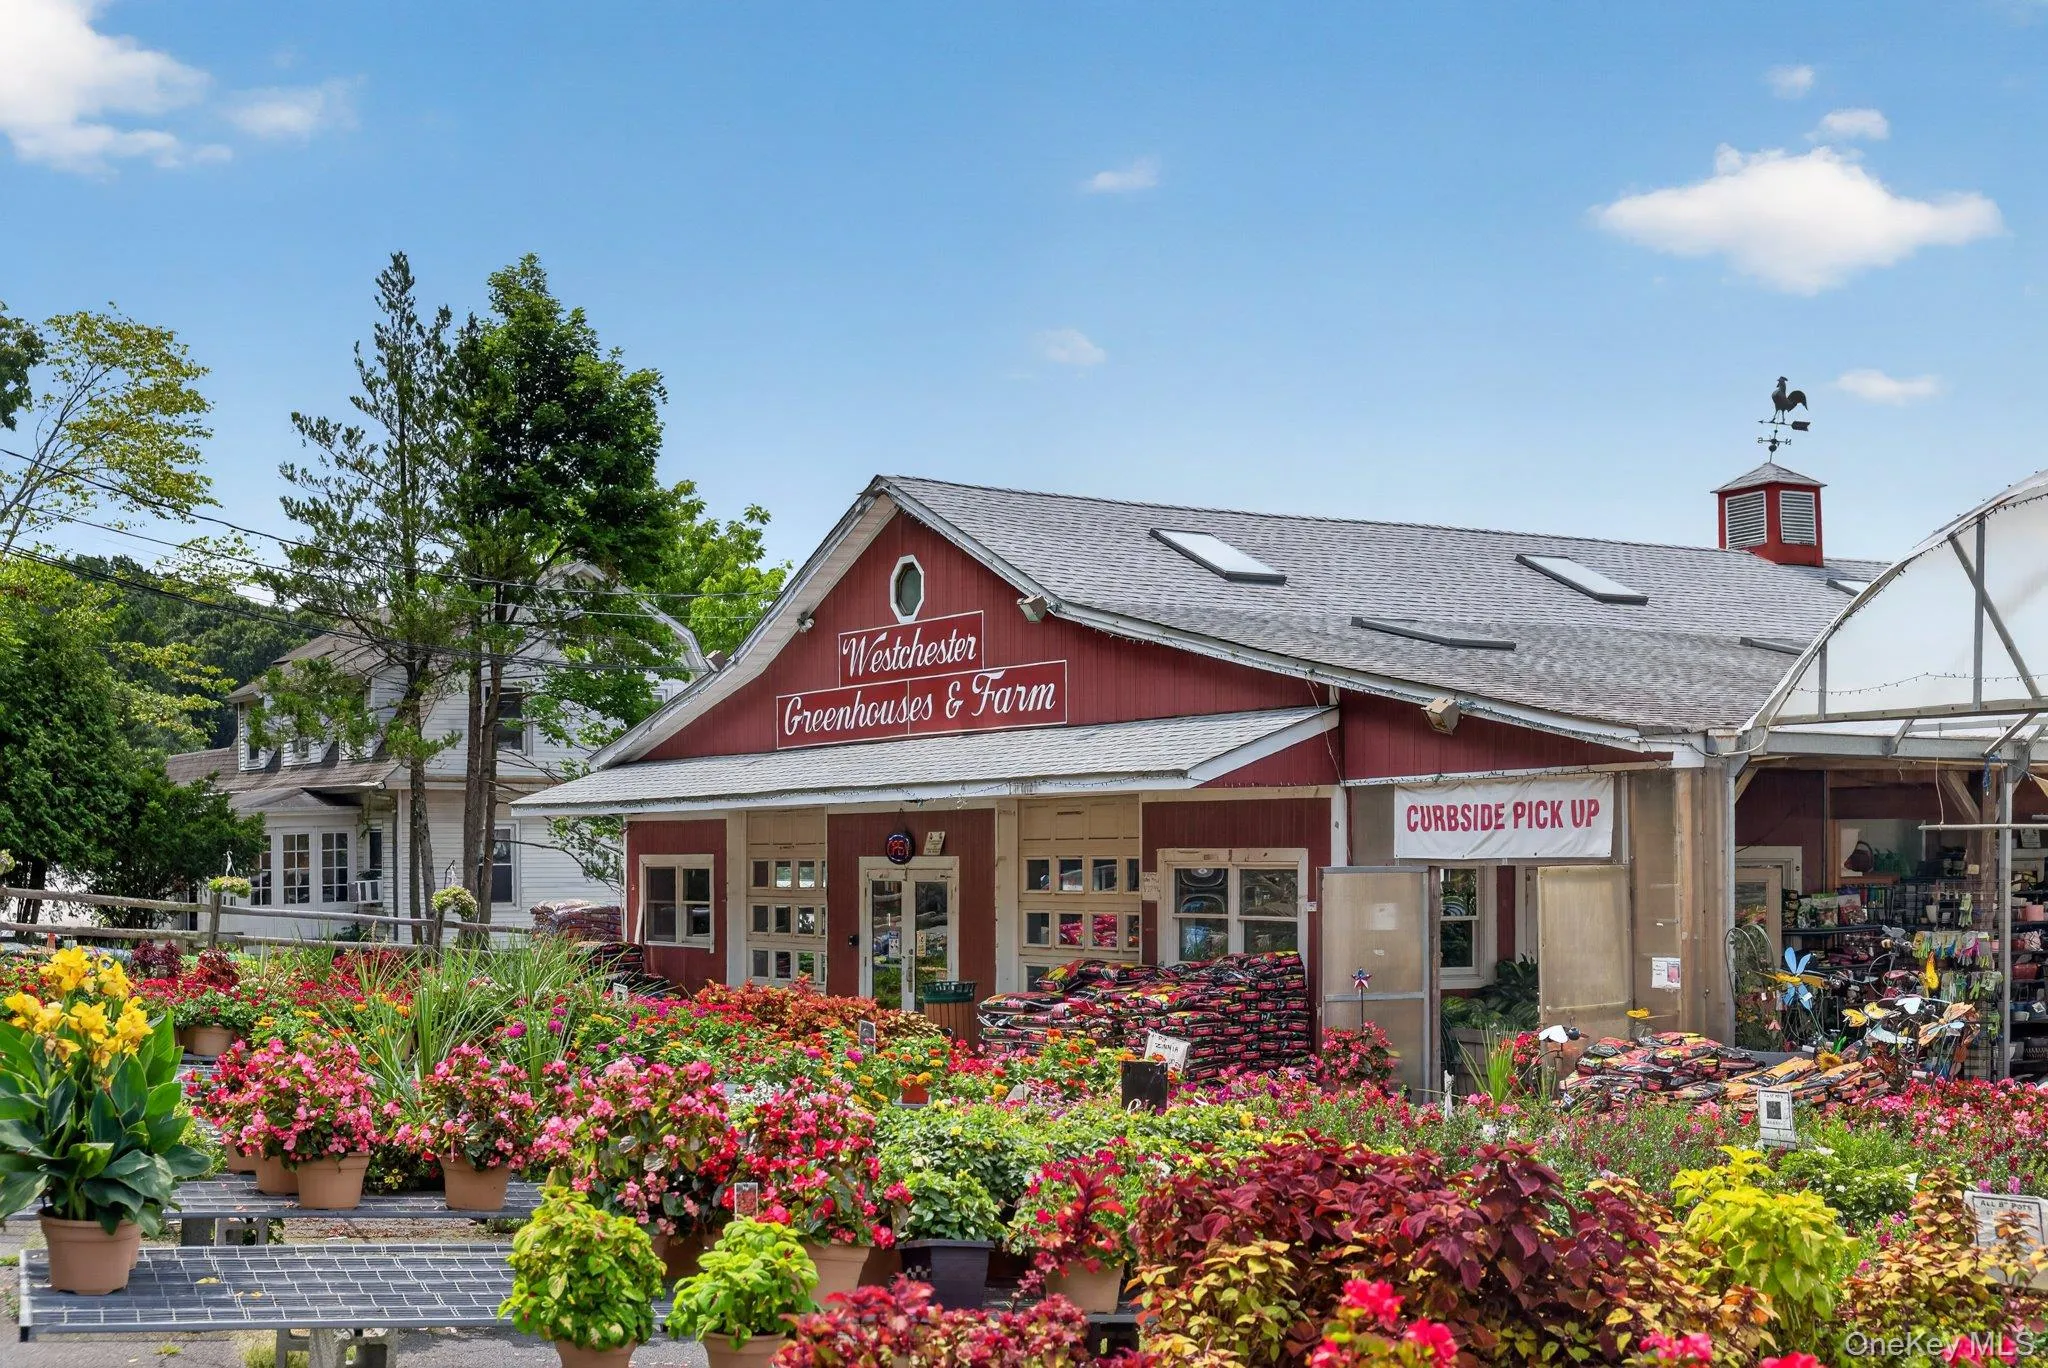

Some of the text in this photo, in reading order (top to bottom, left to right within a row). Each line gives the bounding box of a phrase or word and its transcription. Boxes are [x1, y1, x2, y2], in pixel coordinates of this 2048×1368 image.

[843, 627, 976, 678] Westchester
[784, 668, 1056, 736] Greenhouses & Farm
[1406, 798, 1600, 833] CURBSIDE PICK UP
